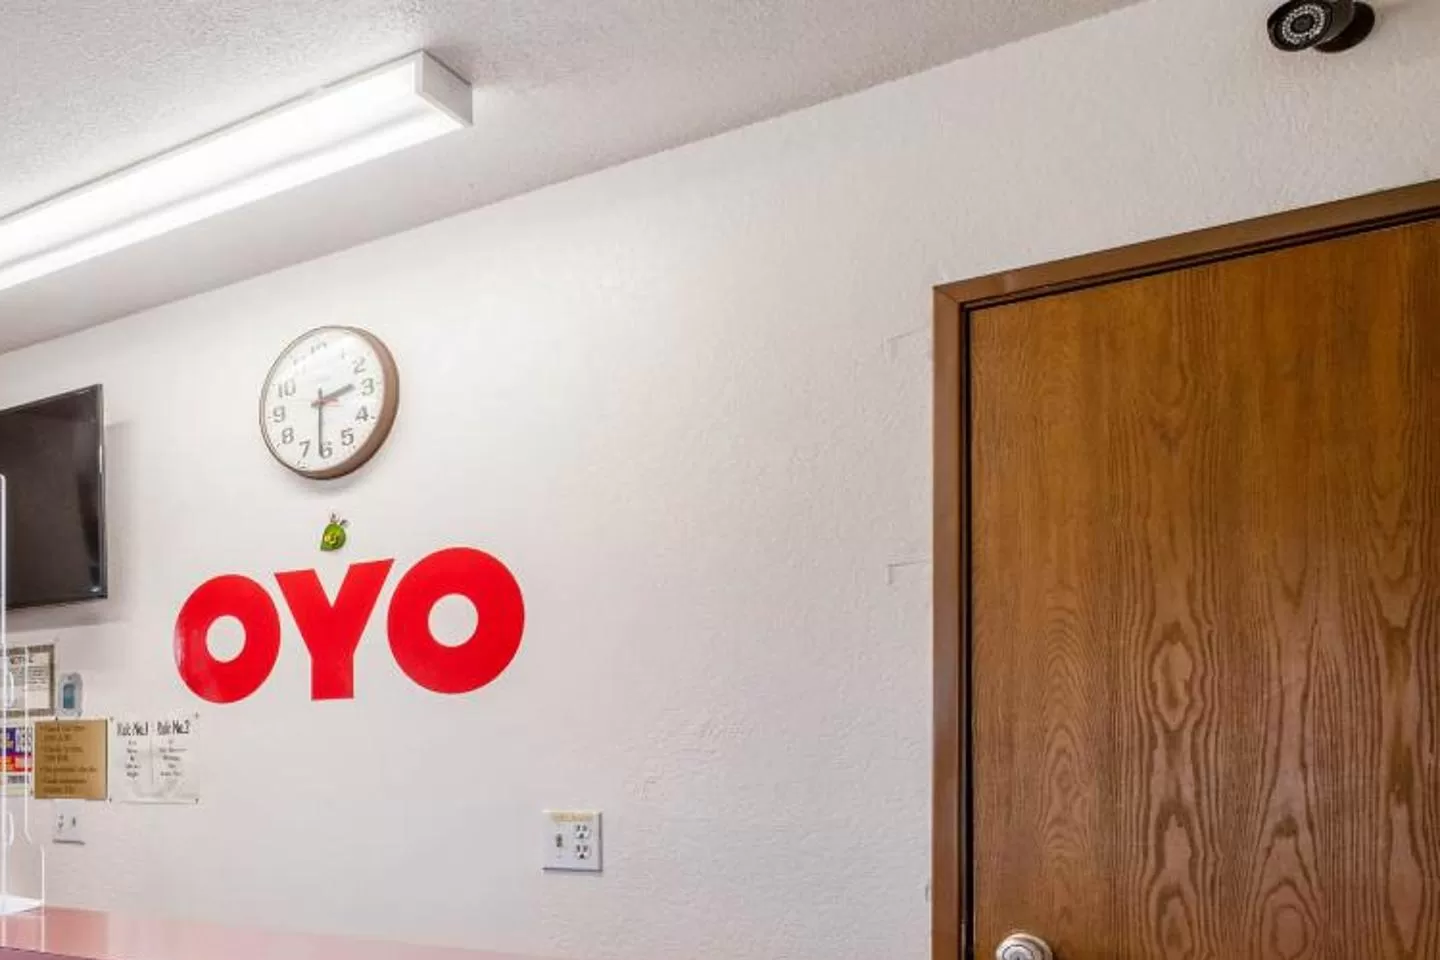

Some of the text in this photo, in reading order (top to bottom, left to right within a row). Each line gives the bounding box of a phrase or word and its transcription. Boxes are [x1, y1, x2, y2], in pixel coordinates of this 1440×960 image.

[352, 357, 366, 374] 2
[278, 379, 296, 398] 10
[361, 378, 374, 396] 3
[273, 405, 285, 423] 9
[355, 406, 369, 421] 4
[281, 427, 294, 445] 8
[341, 428, 354, 446] 5
[300, 441, 310, 458] 7
[173, 547, 525, 704] OYO
